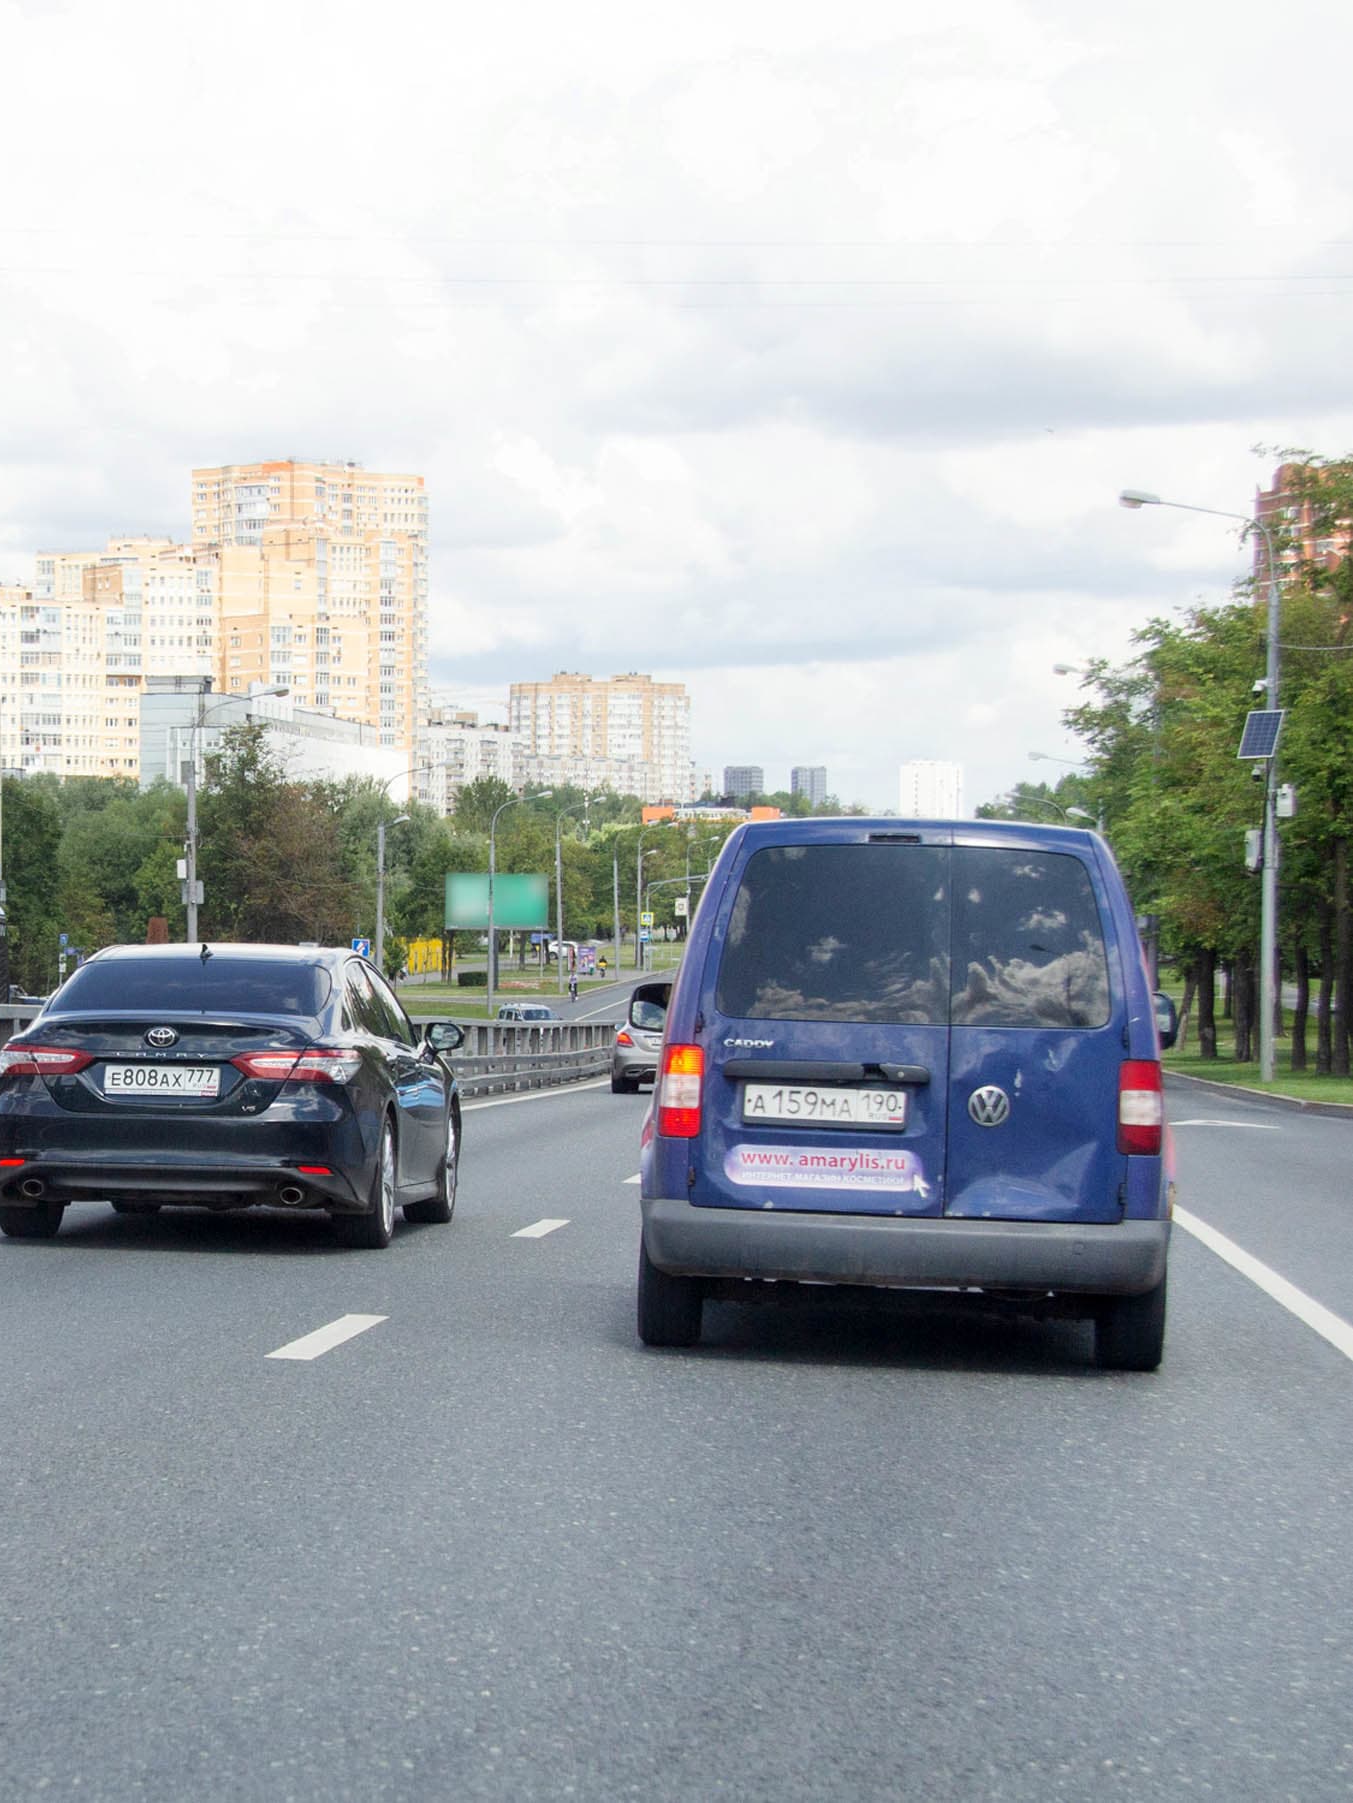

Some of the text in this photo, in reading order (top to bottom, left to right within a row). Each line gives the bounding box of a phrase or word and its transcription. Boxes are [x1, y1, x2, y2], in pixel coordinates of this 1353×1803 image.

[724, 1038, 775, 1048] CADDY
[187, 1069, 215, 1083] 777
[862, 1093, 897, 1112] 190
[741, 1152, 905, 1172] www. amarylis.ru
